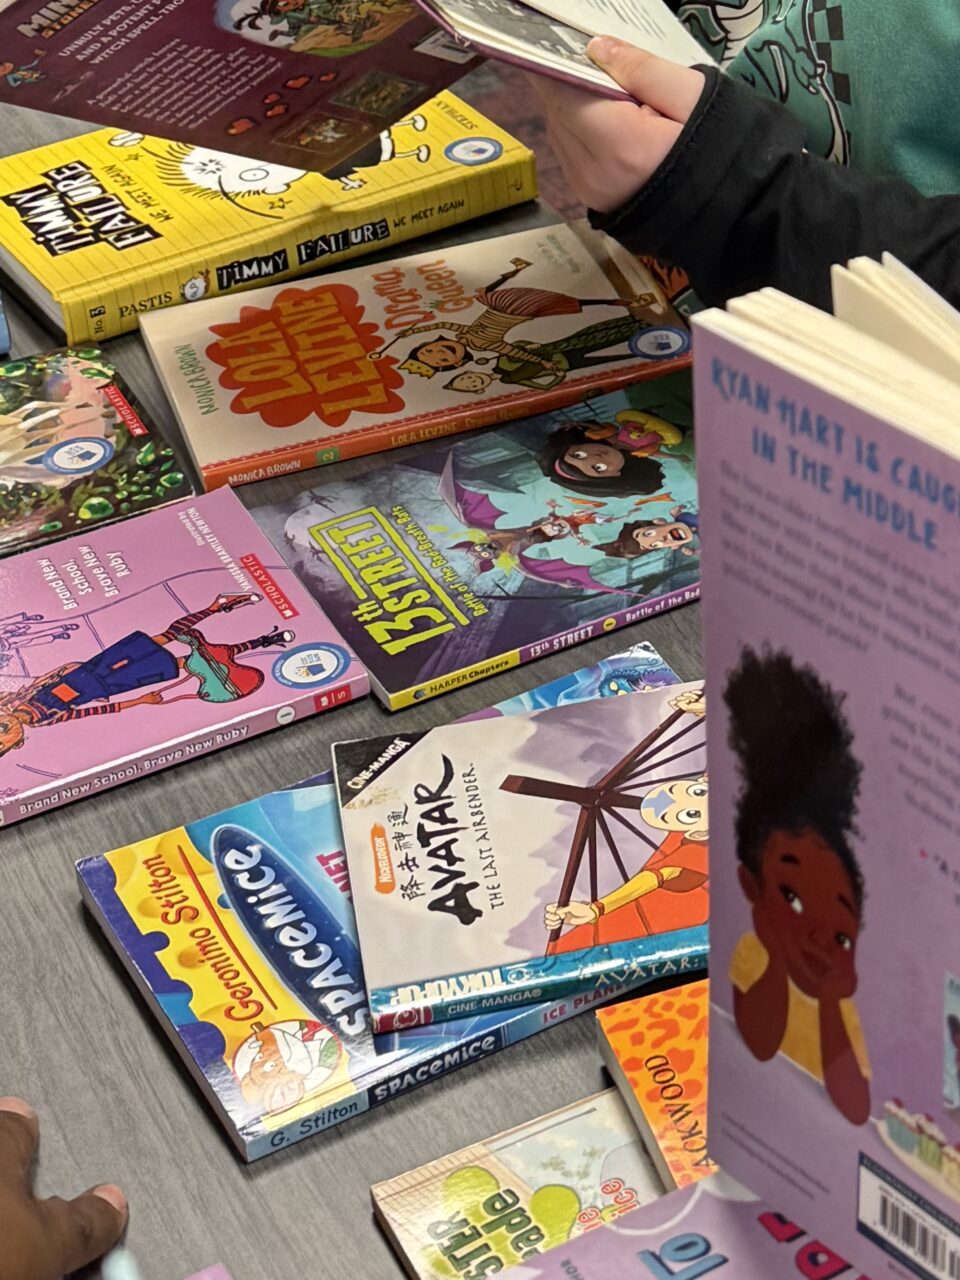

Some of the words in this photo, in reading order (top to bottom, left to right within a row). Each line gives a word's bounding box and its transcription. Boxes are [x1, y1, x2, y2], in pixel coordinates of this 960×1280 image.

[58, 24, 104, 57] UNRULY
[103, 1, 135, 26] PETS,
[75, 40, 104, 62] AND
[109, 1, 156, 39] POTENT
[89, 36, 130, 66] WITCH
[127, 12, 165, 42] SPELL
[435, 100, 479, 130] STEPHAN
[102, 164, 137, 192] AGAIN
[126, 188, 161, 210] MEET
[49, 162, 155, 250] FAILURE
[150, 208, 174, 223] WE
[299, 222, 389, 261] FAILURE
[393, 216, 407, 228] WE
[411, 207, 434, 224] MEET
[437, 199, 465, 216] AGAIN
[119, 291, 173, 318] PASTIS
[370, 266, 436, 331] Drama
[415, 258, 474, 314] Queen
[174, 343, 202, 377] BROWN
[216, 320, 313, 410] LOLA
[279, 291, 389, 416] LEVINE
[103, 385, 139, 429] SCHOLASTIC
[186, 375, 220, 416] MONICA
[711, 355, 771, 415] RYAN
[778, 395, 845, 454] HART
[855, 435, 880, 474] IS
[228, 468, 267, 485] MONICA
[266, 459, 301, 479] BROWN
[322, 451, 335, 464] 2
[391, 431, 418, 448] LOLA
[419, 422, 458, 442] LEVINE
[752, 426, 777, 465] IN
[787, 442, 832, 495] THE
[187, 507, 211, 534] NEWTON
[391, 505, 412, 525] Bats
[79, 545, 101, 568] New
[106, 551, 131, 578] Ruby
[204, 533, 233, 563] BRANTLEY
[327, 521, 431, 613] STREET
[404, 522, 447, 569] Bad-Breath
[38, 558, 60, 581] New
[61, 558, 93, 595] School,
[93, 567, 119, 597] Brave
[226, 561, 252, 592] VANESSA
[243, 555, 289, 612] SCHOLASTIC
[441, 565, 459, 583] the
[449, 582, 468, 593] of
[49, 580, 78, 610] Brand
[463, 592, 489, 617] Battle
[530, 641, 550, 658] 13th
[553, 625, 594, 651] STREET
[625, 607, 653, 622] Battle
[655, 600, 665, 612] of
[668, 596, 683, 609] the
[19, 794, 59, 815] Brand
[62, 781, 91, 800] New
[93, 764, 142, 788] School,
[144, 750, 183, 770] Brave
[185, 738, 214, 756] New
[215, 725, 249, 745] Ruby
[347, 737, 411, 790] CINE-MANGA
[462, 766, 490, 842] AIRBENDER
[376, 836, 393, 884] NICKELODEON
[414, 753, 483, 926] AVATAR
[479, 847, 498, 879] LAST
[142, 853, 200, 926] Stilton
[486, 882, 505, 910] THE
[189, 927, 264, 1022] Geronimo
[543, 1005, 568, 1025] ICE
[270, 1129, 290, 1149] G.
[300, 1101, 359, 1135] Stilton
[645, 1055, 718, 1168] ACKWOOD
